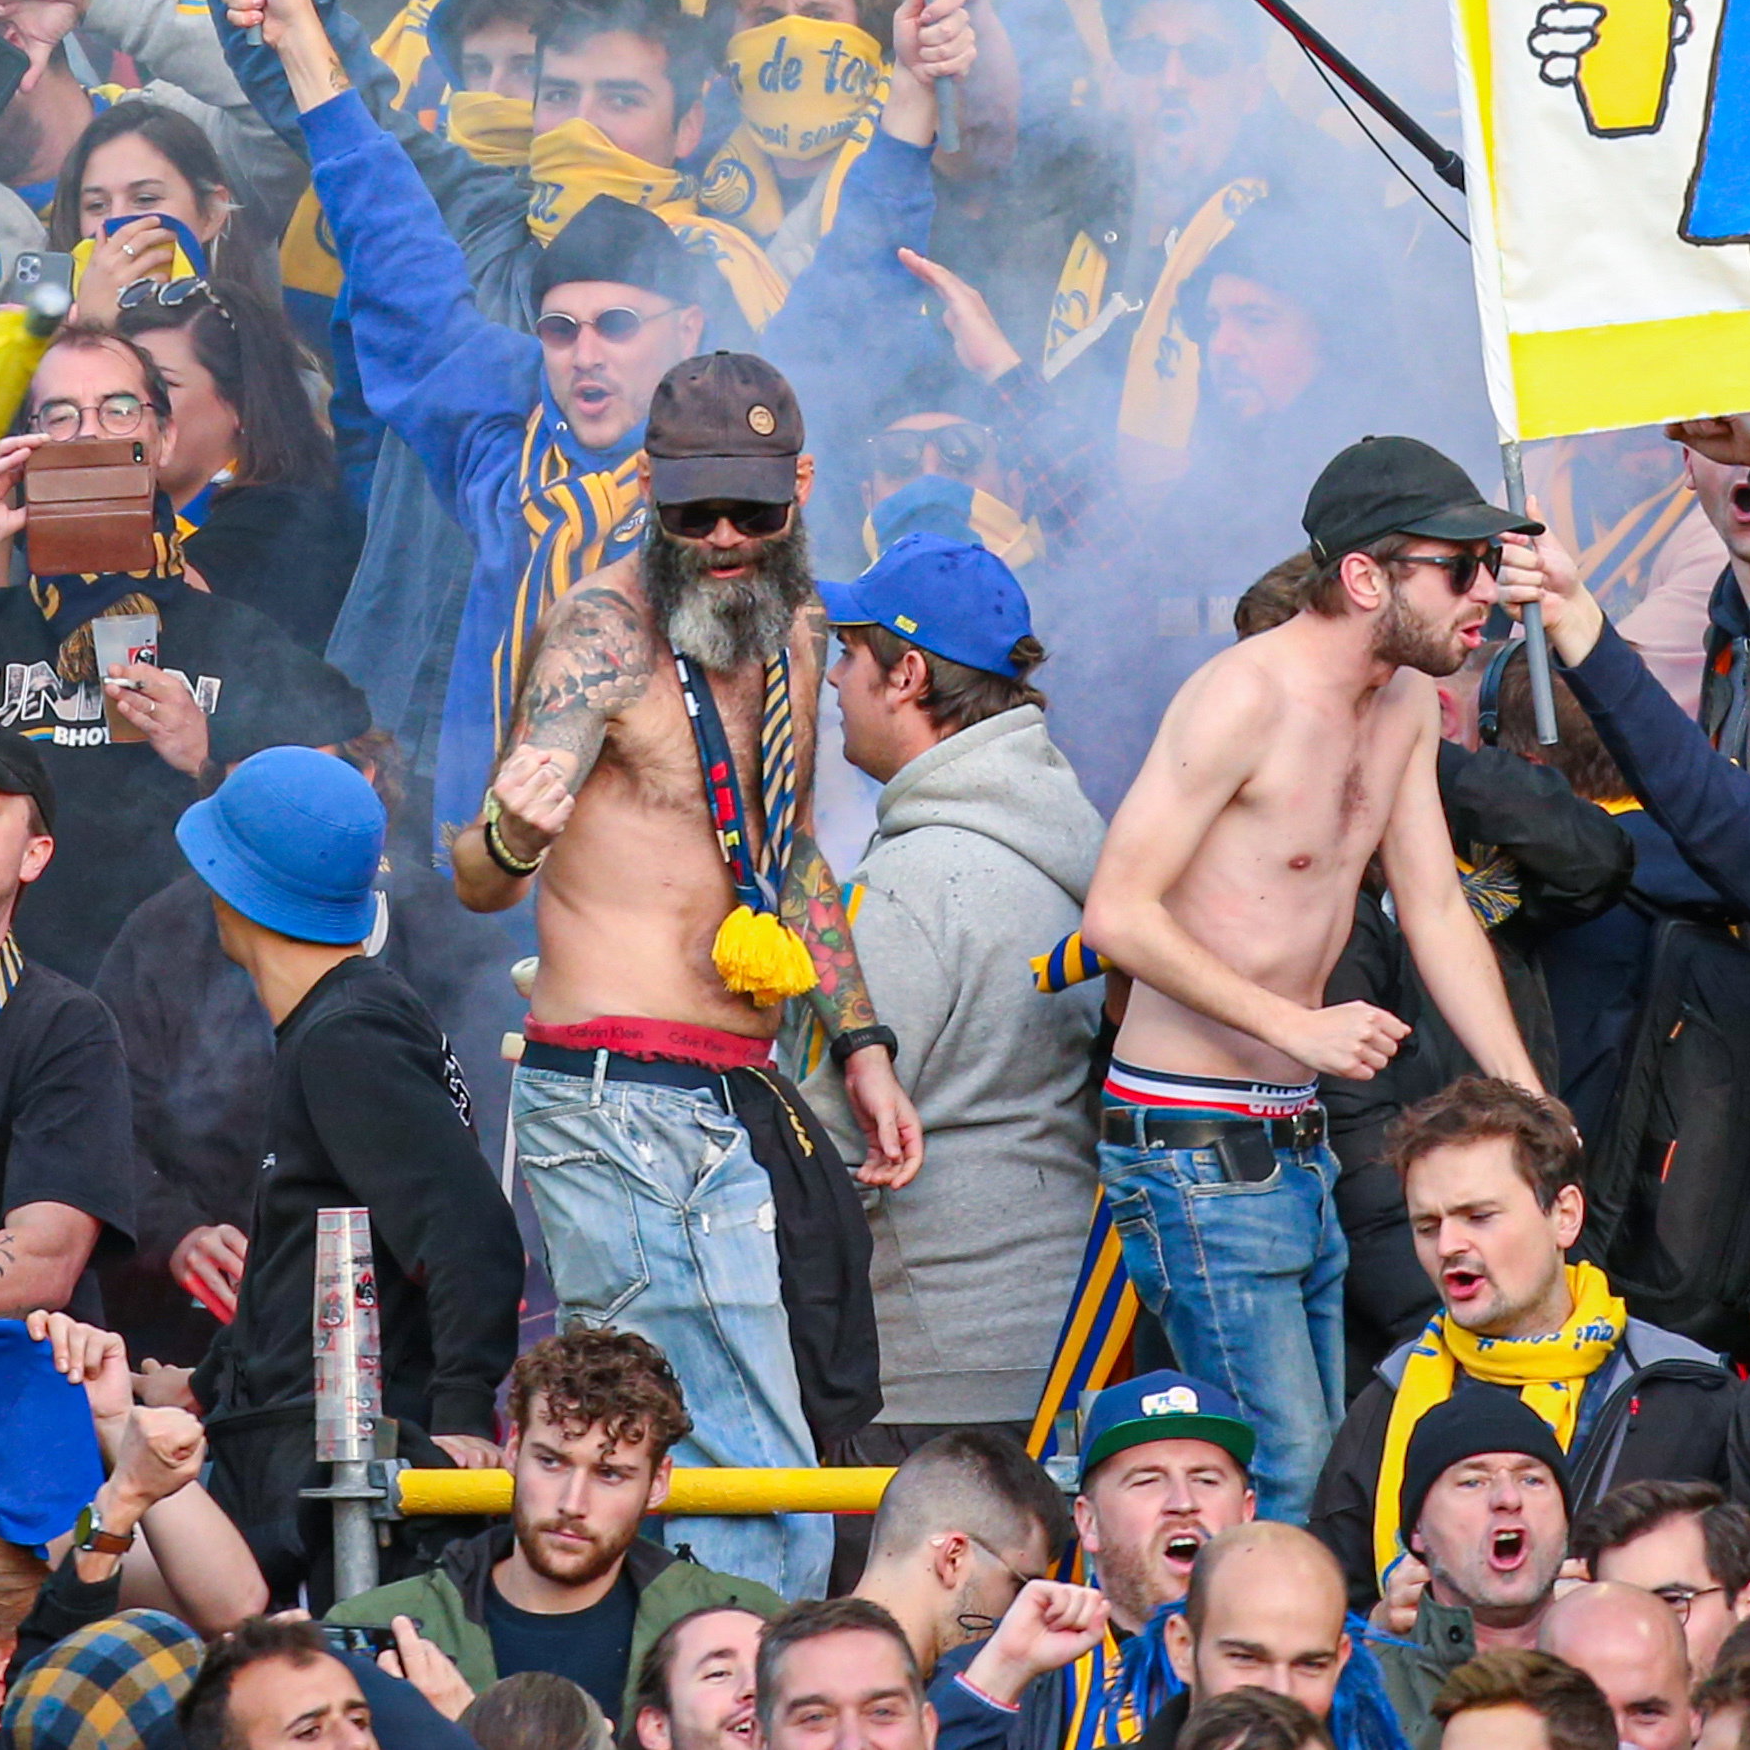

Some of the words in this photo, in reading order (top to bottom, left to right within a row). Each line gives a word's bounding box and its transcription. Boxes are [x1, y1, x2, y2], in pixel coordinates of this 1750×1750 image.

[758, 35, 803, 94] de
[567, 1024, 608, 1039] Calvin
[611, 1025, 644, 1040] Klein
